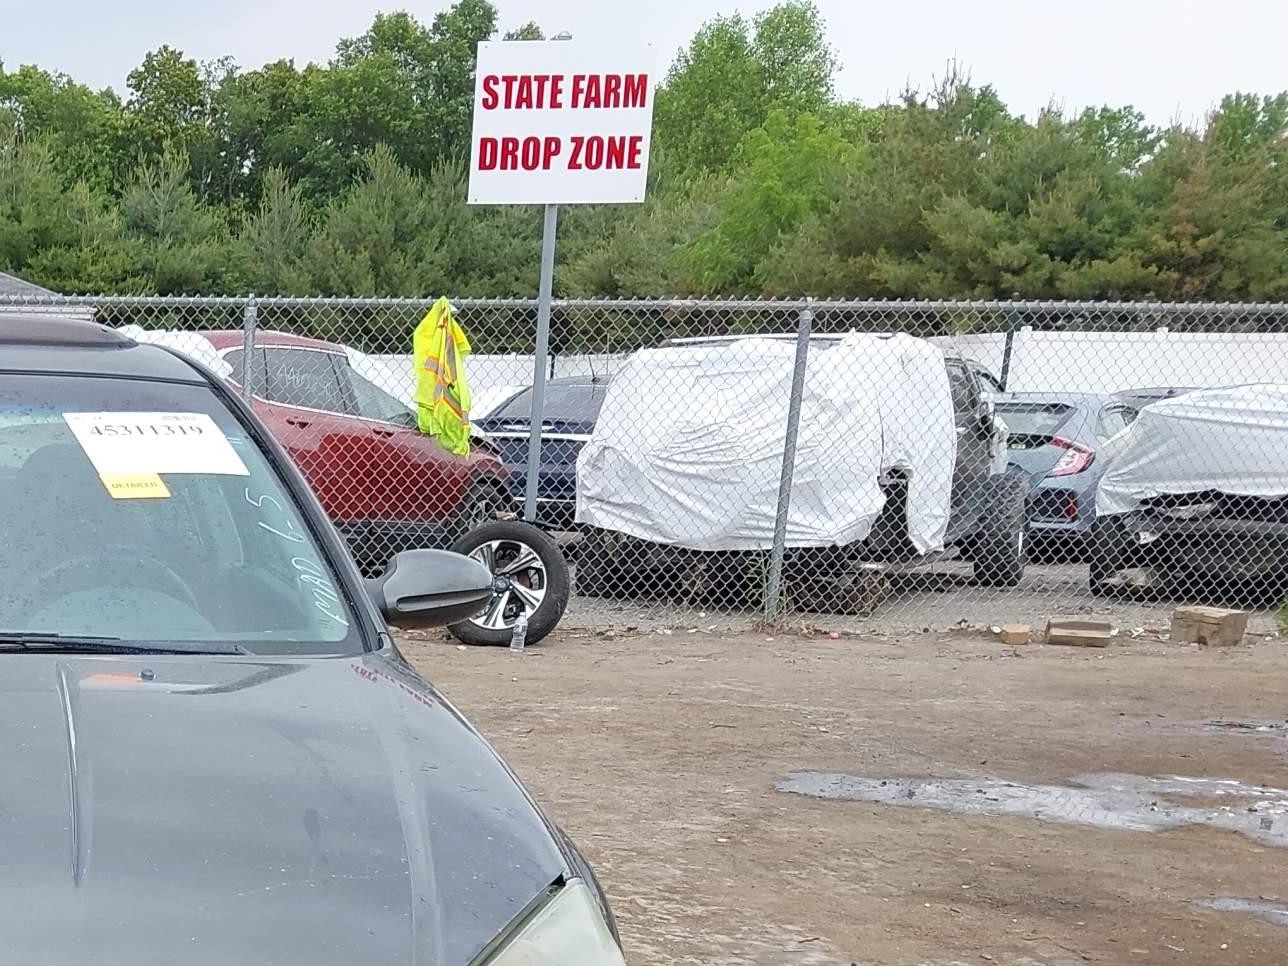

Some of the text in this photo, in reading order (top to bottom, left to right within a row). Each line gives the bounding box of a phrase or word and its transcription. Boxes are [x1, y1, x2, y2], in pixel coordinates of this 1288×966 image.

[482, 74, 649, 110] STATE FARM
[478, 136, 643, 171] DROP ZONE
[90, 424, 203, 436] 45311319
